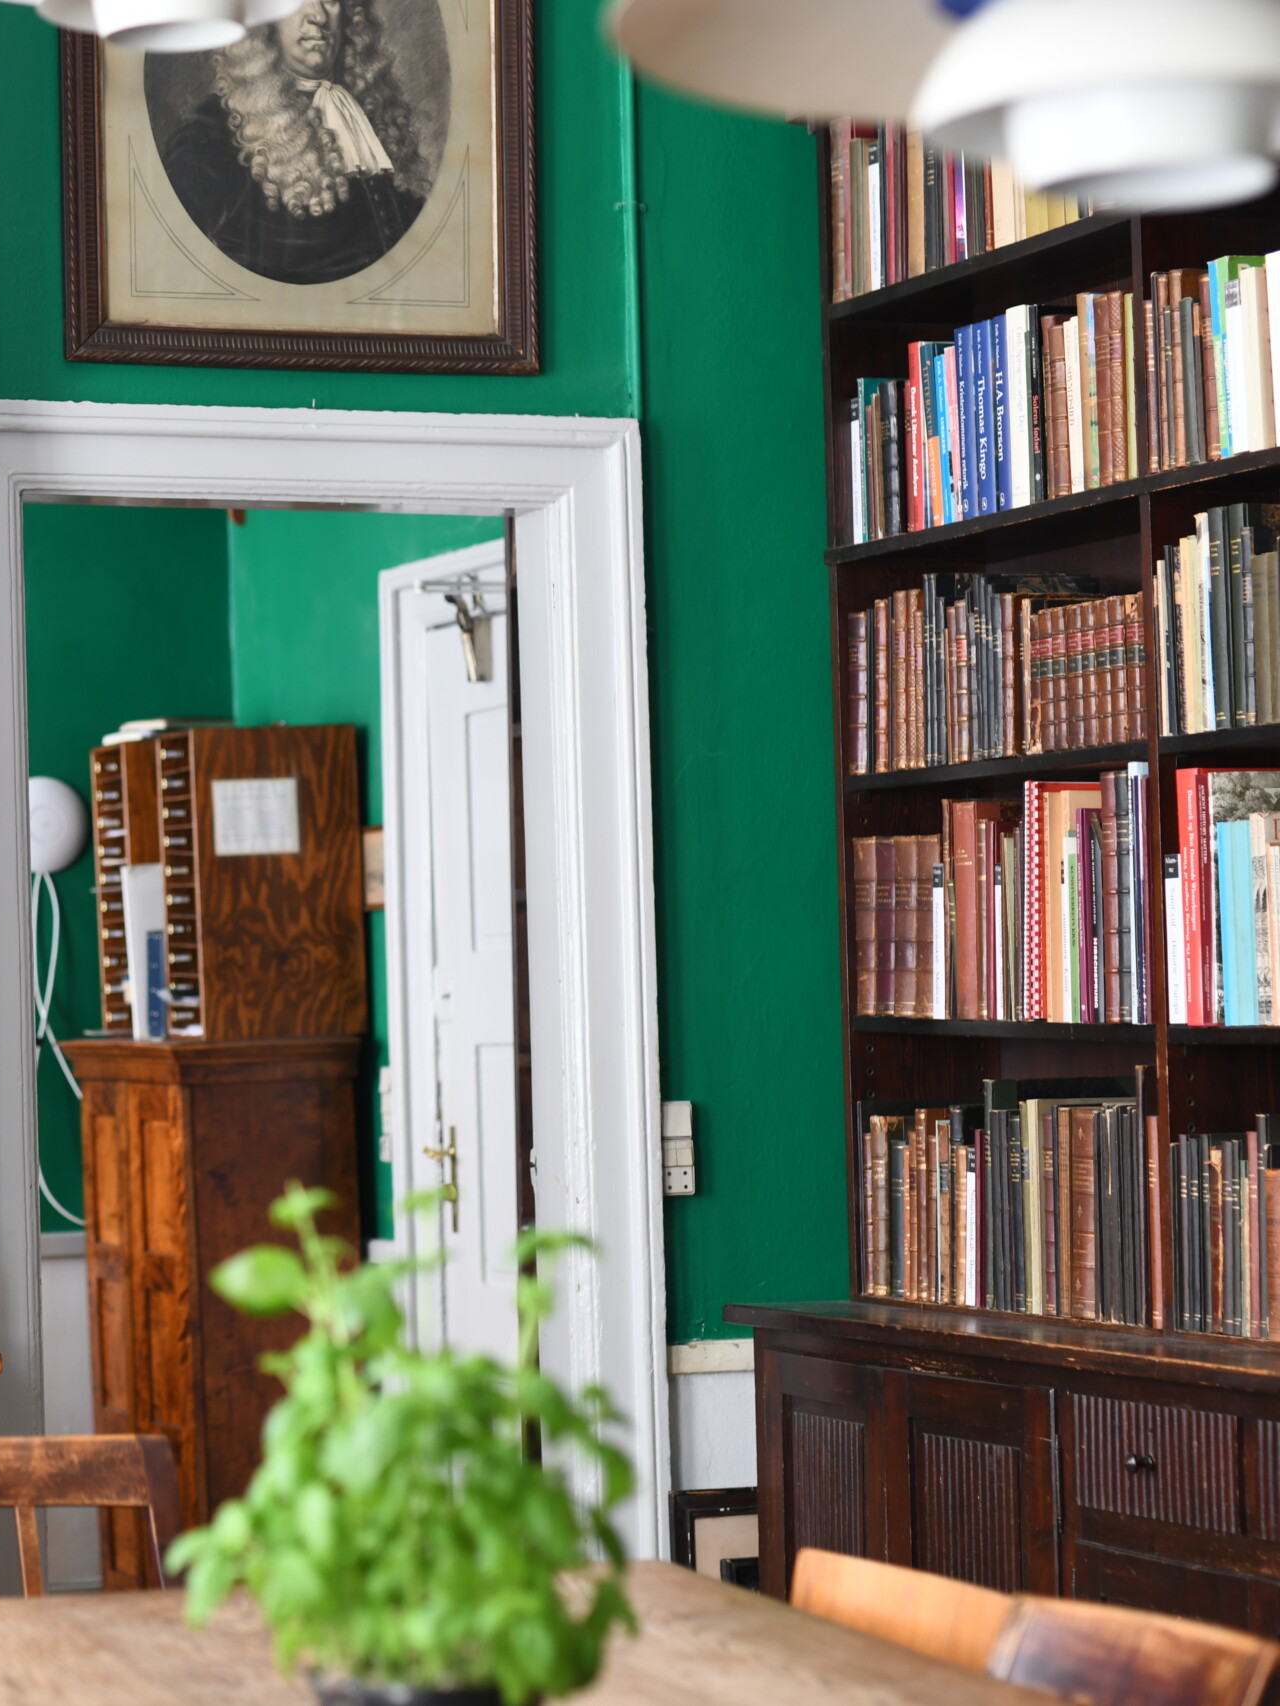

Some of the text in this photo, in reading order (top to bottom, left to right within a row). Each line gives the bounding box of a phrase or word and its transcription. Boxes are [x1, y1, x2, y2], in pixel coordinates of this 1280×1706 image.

[959, 380, 967, 457] Kristendommens
[977, 376, 987, 480] Thomas Kingo
[996, 405, 1004, 462] Brorson
[911, 458, 919, 497] Analyse
